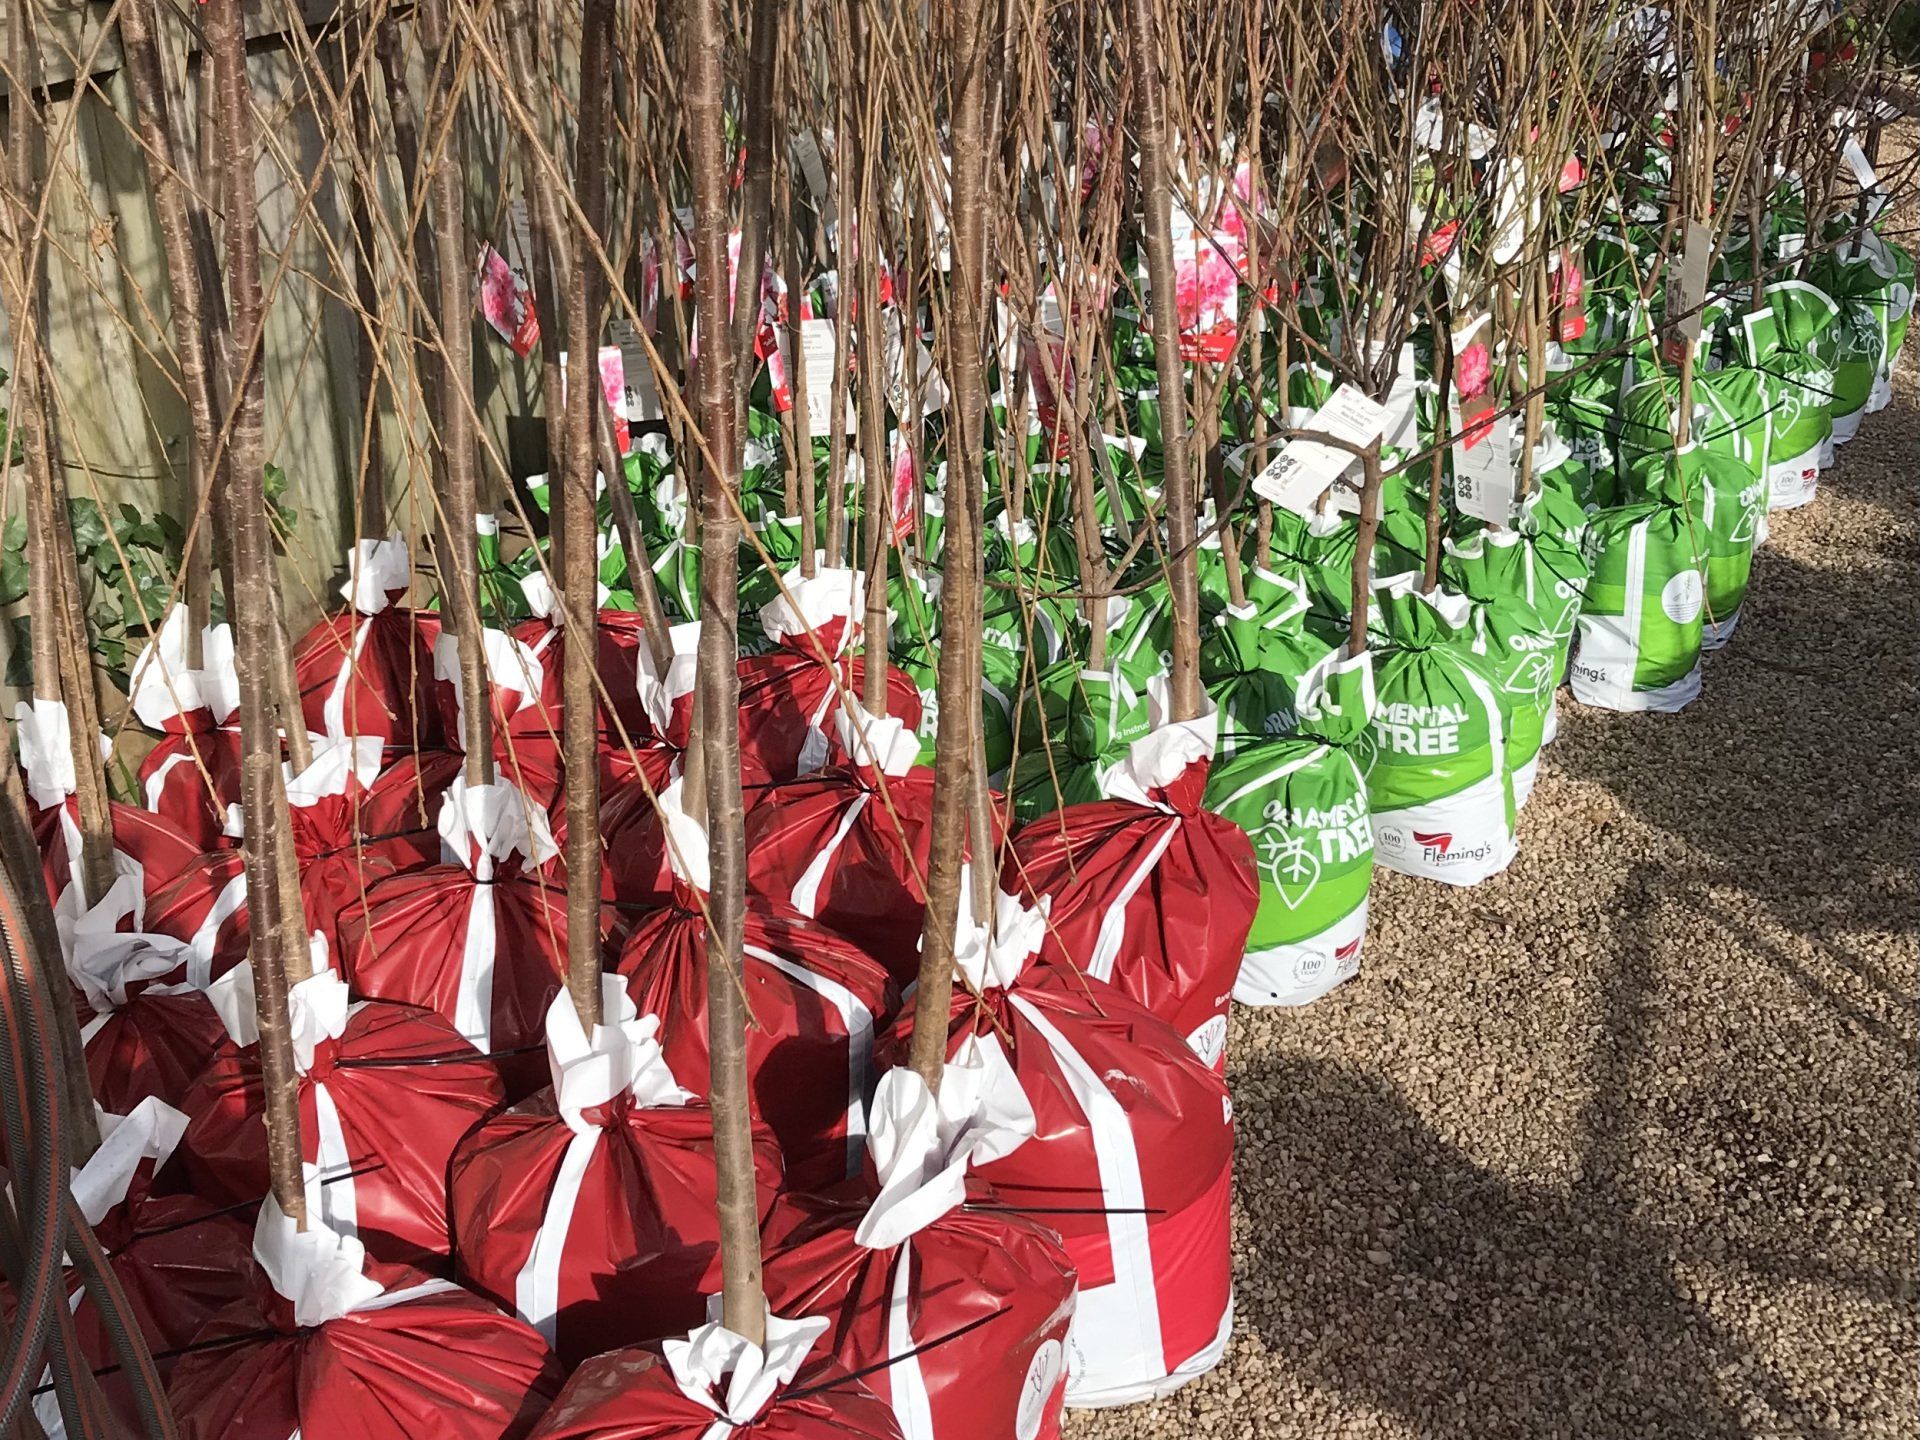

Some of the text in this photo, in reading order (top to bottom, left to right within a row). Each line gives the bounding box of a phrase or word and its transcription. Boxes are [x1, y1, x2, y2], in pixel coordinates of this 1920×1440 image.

[1374, 701, 1469, 727] MENTAL
[1371, 719, 1460, 755] TREE
[1383, 832, 1401, 844] 100
[1423, 841, 1491, 863] Fleming's
[1301, 960, 1321, 970] 100
